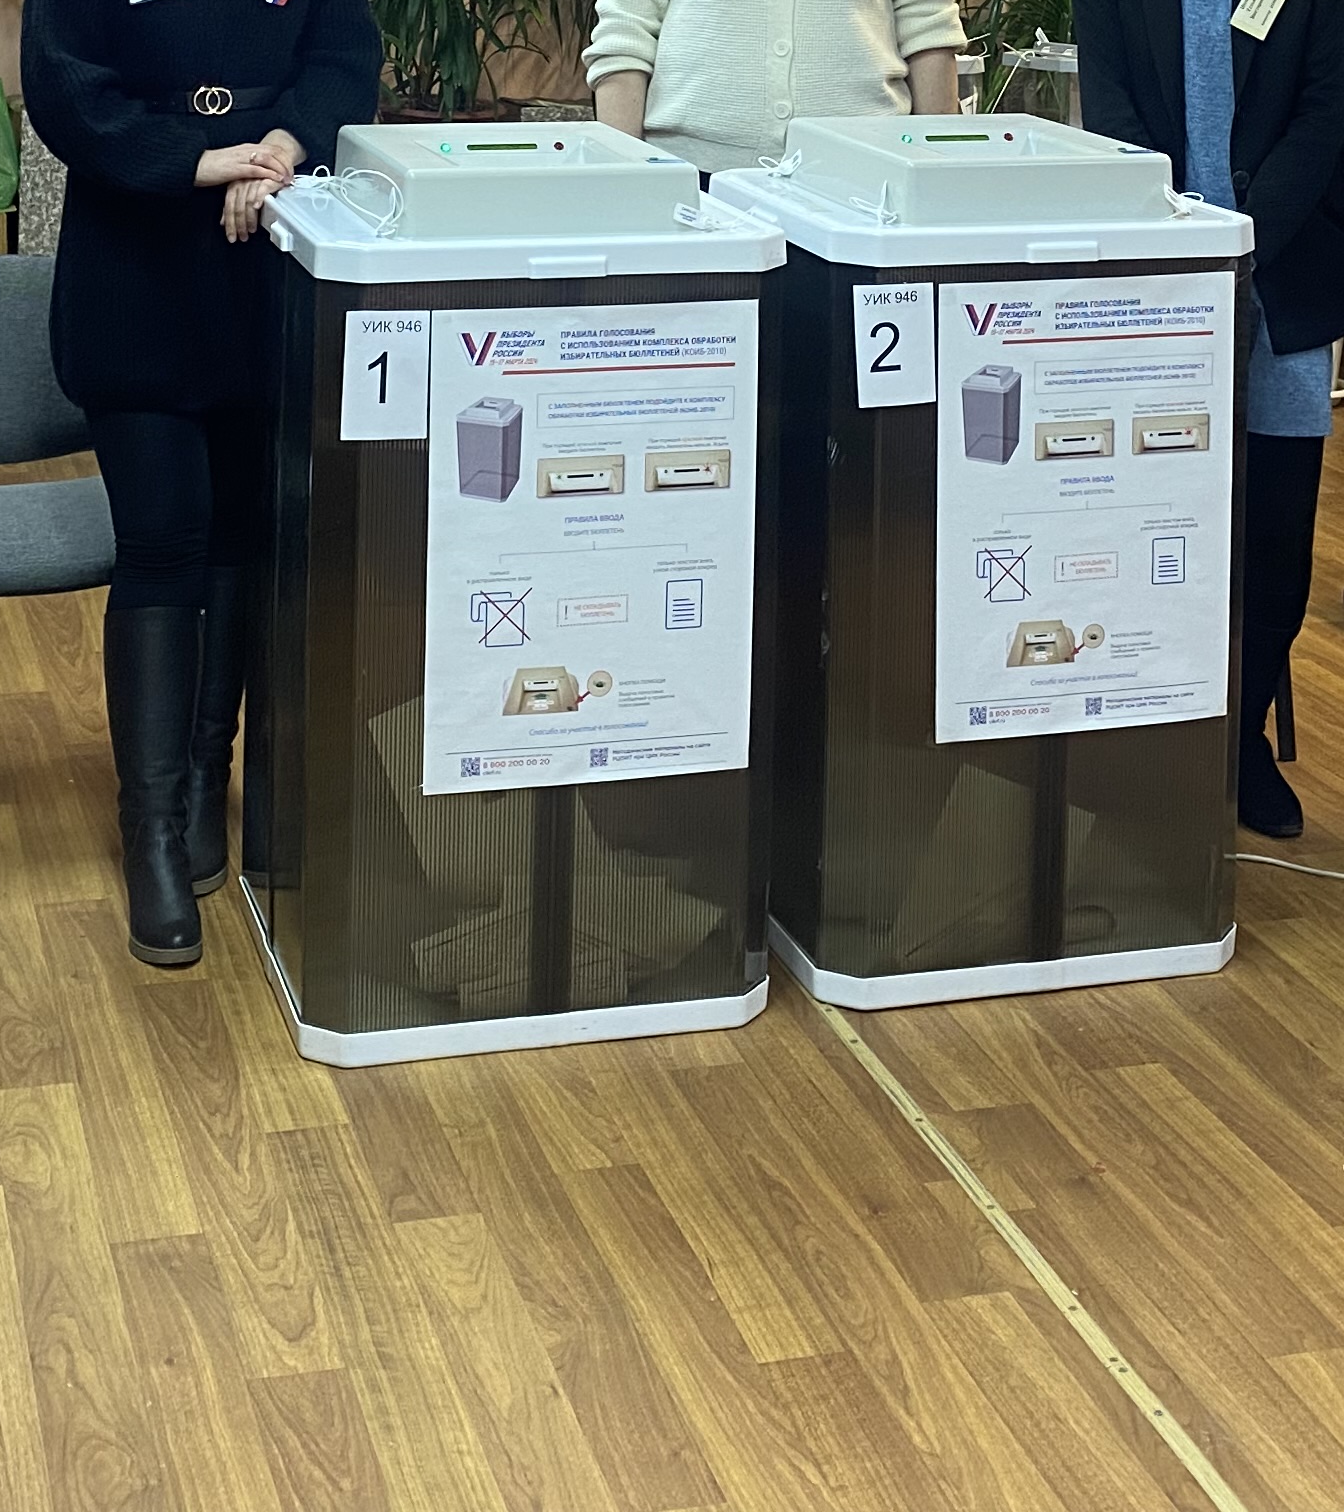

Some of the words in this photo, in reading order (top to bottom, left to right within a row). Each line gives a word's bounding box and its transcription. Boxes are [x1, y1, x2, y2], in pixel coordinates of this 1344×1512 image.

[863, 292, 891, 306] УИК
[894, 291, 918, 304] 946
[1055, 301, 1088, 310] ПРАВИЛА
[1090, 299, 1140, 308] ГОЛОСОВАНИЯ
[1061, 310, 1127, 319] ИСПОЛЬЗОВАНИЕМ
[1129, 308, 1170, 316] КОМПЛЕКСА
[1172, 306, 1214, 314] ОБРАБОТКИ
[362, 321, 392, 333] УИК
[397, 320, 422, 333] 946
[1055, 320, 1115, 330] ИЗБИРАТЕЛЬНЫХ
[500, 330, 535, 339] ВЫБОРЫ
[560, 329, 597, 338] ПРАВИЛА
[599, 328, 655, 337] ГОЛОСОВАНИЯ
[496, 339, 545, 348] ПРЕЗИДЕНТА
[567, 338, 640, 349] ИСПОЛЬЗОВАНИЕМ
[643, 337, 689, 346] КОМПЛЕКСА
[691, 336, 736, 345] ОБРАБОТКИ
[870, 322, 901, 372] 2
[492, 350, 524, 358] РОССИИ
[560, 350, 627, 360] ИЗБИРАТЕЛЬНЫХ
[628, 347, 680, 358] БЮЛЛЕТЕНЕЙ
[681, 347, 726, 357] (КОИБ-2010)
[367, 351, 388, 403] 1
[508, 760, 524, 768] 200
[540, 758, 550, 766] 20
